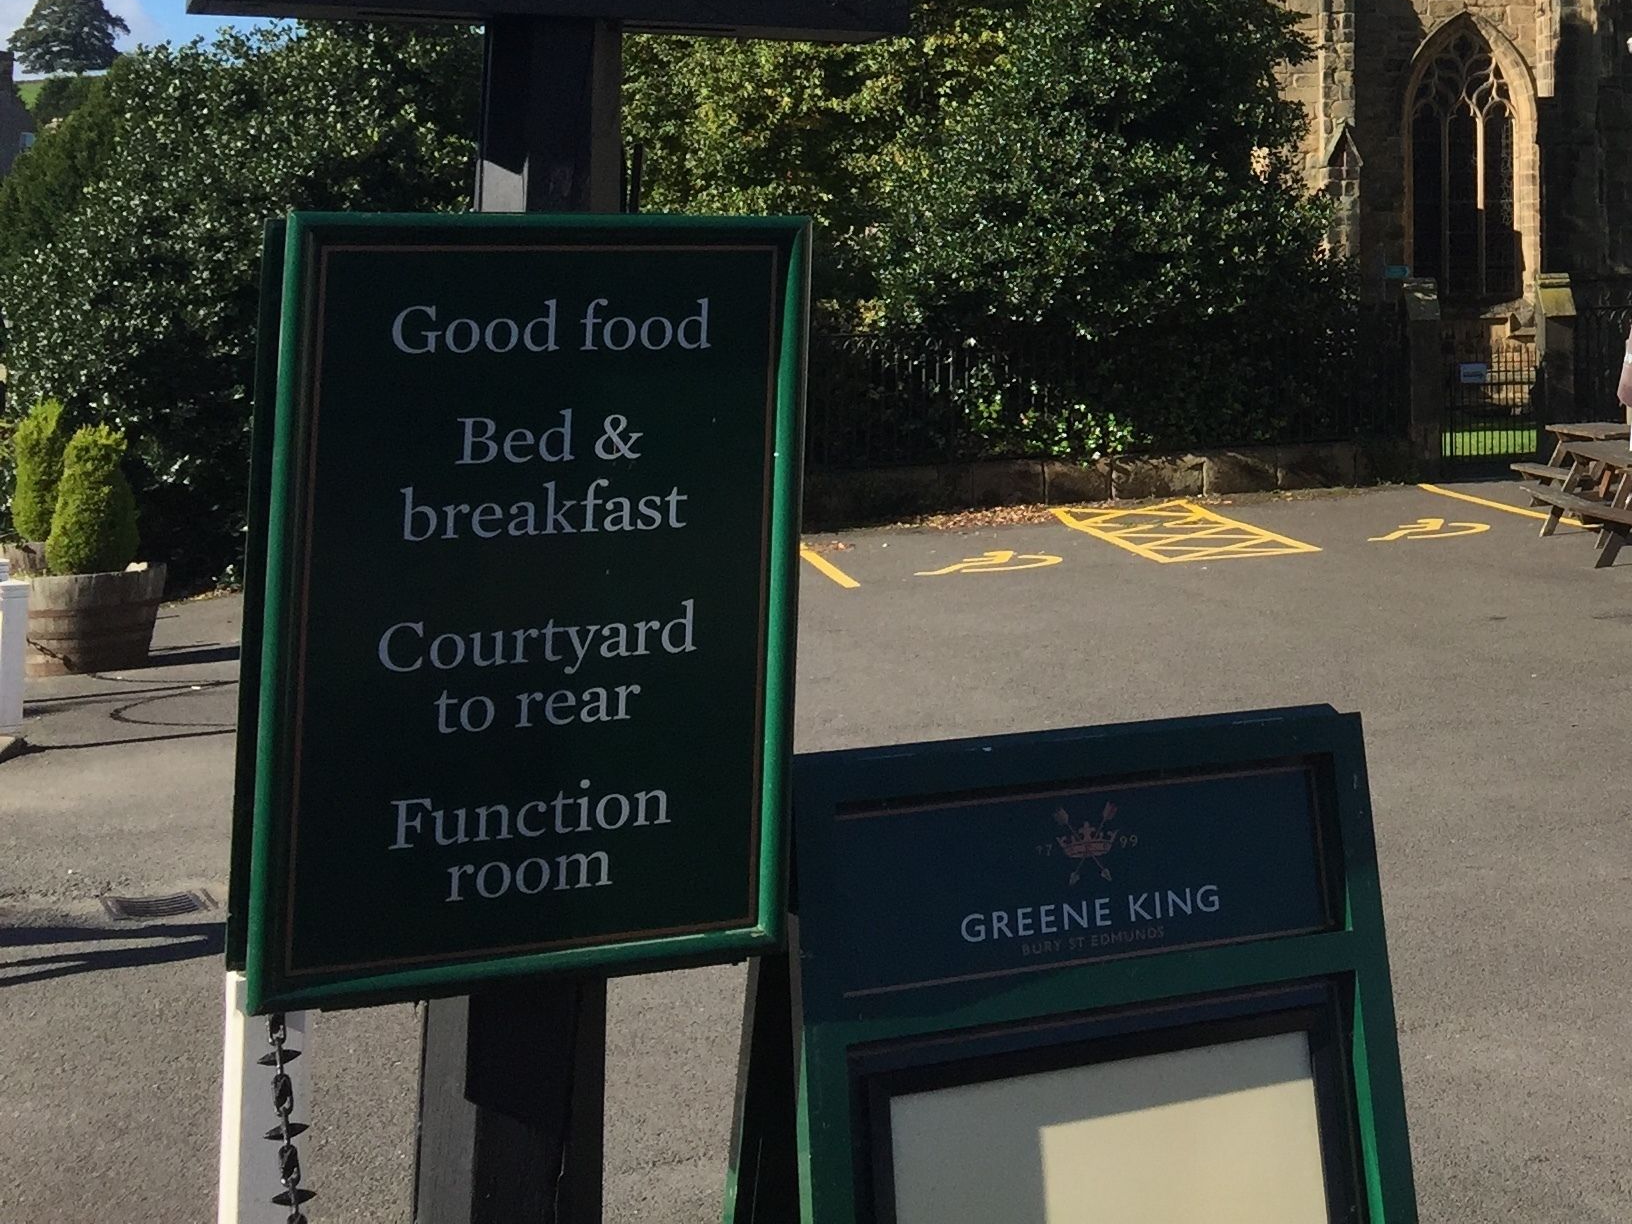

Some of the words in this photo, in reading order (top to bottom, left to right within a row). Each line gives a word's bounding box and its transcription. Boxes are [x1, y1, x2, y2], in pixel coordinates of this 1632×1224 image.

[391, 298, 559, 354] Good
[579, 298, 713, 352] food
[455, 410, 575, 464] Bed
[594, 412, 645, 460] &
[402, 479, 689, 543] breakfast
[378, 599, 698, 675] Courtyard
[434, 689, 495, 734] to
[515, 683, 641, 729] rear
[388, 779, 672, 849] Function
[445, 848, 613, 903] room
[960, 897, 1113, 944] GREENE
[1128, 884, 1221, 924] KING
[1022, 938, 1061, 956] BURY
[1068, 936, 1085, 950] ST
[1091, 925, 1165, 947] EDMUNDS
